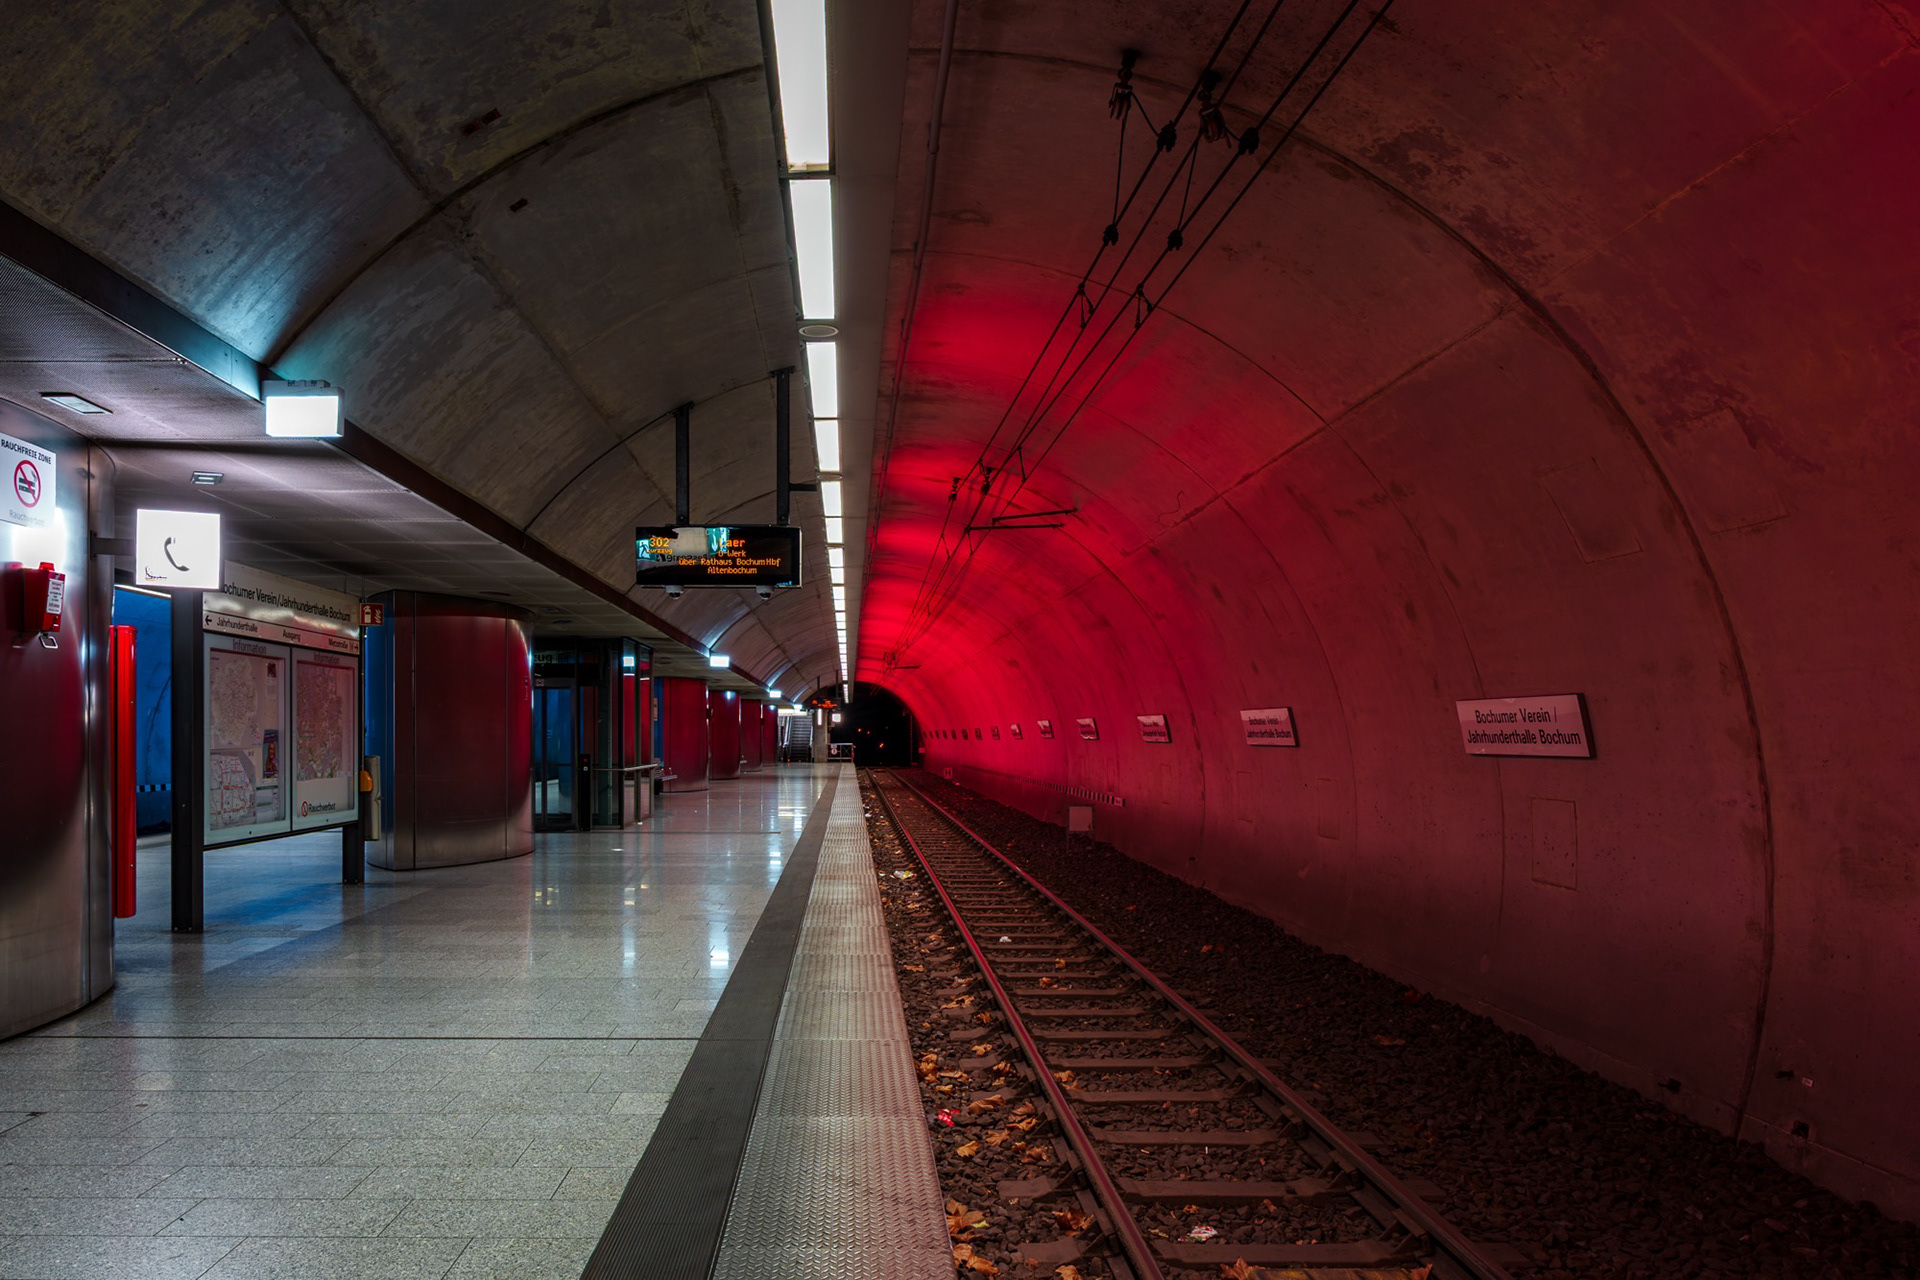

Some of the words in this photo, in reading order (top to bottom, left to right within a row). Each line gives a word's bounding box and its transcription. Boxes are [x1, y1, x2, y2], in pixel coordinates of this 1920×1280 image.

[1, 439, 37, 459] RAUCHFREIE
[38, 452, 52, 465] ZONE
[649, 537, 669, 548] 302
[719, 538, 746, 548] Laer
[700, 557, 732, 566] Rathaus
[707, 566, 757, 574] Altenbochum
[223, 581, 255, 600] ochumer
[329, 605, 351, 622] Bochum
[216, 617, 258, 633] Jahrhunderthalle
[282, 629, 301, 643] Ausgang
[233, 637, 267, 655] Information
[1475, 709, 1517, 724] Bochumer
[1519, 707, 1551, 723] Verein
[1467, 729, 1537, 744] Jahrhunderthalle
[1538, 729, 1582, 745] Bochum
[308, 802, 336, 813] Rauchverbot
